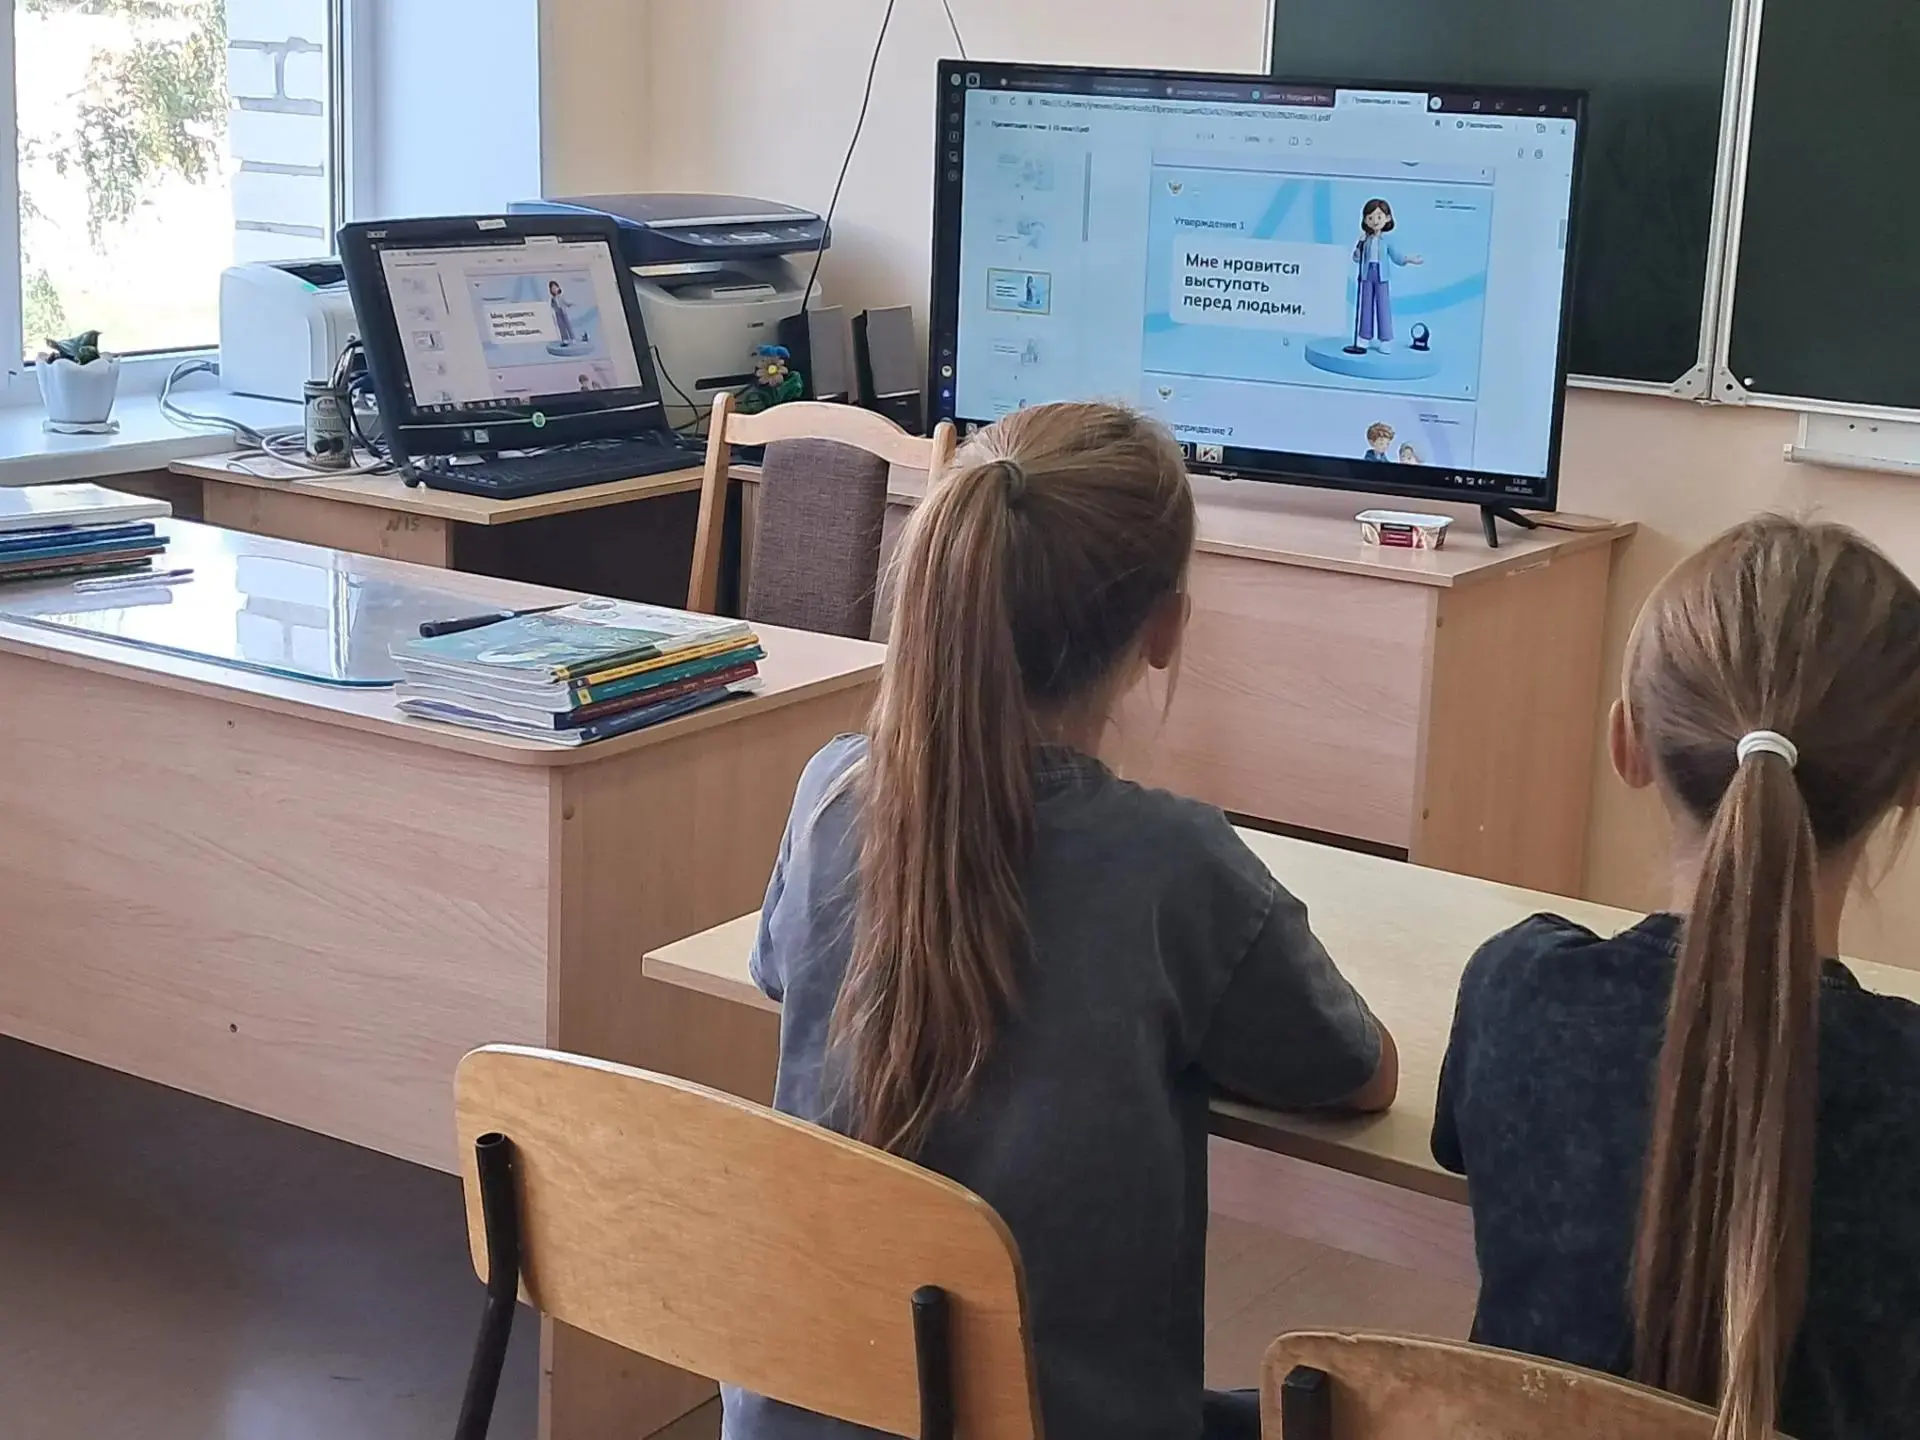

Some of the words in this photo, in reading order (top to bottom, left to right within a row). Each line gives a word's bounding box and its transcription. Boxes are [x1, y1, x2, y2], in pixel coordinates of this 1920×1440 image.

[1174, 215, 1237, 229] Утверждение
[1239, 220, 1245, 230] 1
[1185, 252, 1219, 269] Мне
[1223, 258, 1300, 275] нравится
[1184, 275, 1270, 293] выступать
[1183, 295, 1232, 311] перед
[1236, 299, 1306, 316] людьми.
[1228, 426, 1234, 436] 2
